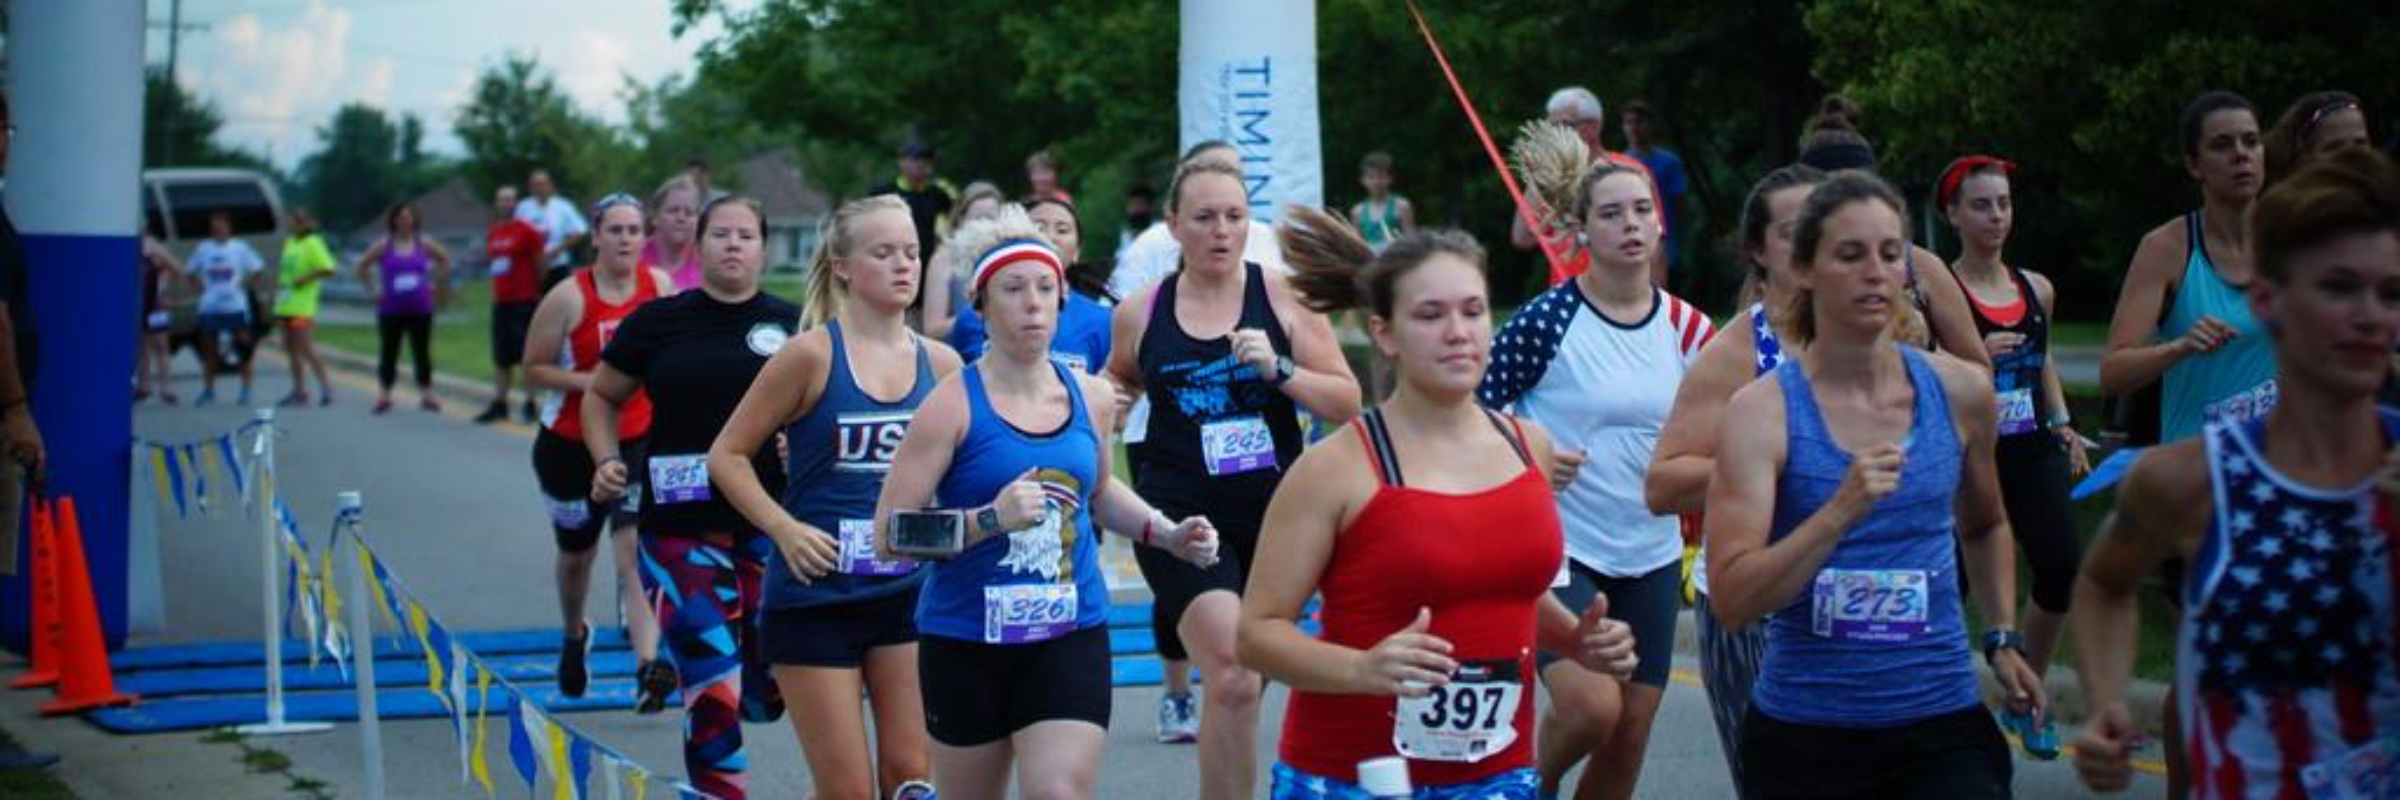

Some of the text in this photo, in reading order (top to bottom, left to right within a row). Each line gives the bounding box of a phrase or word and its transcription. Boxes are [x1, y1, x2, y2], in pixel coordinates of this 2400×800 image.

[1235, 56, 1272, 223] TIMIN
[1007, 596, 1065, 621] 326
[1843, 587, 1918, 616] 273
[1420, 685, 1504, 730] 397
